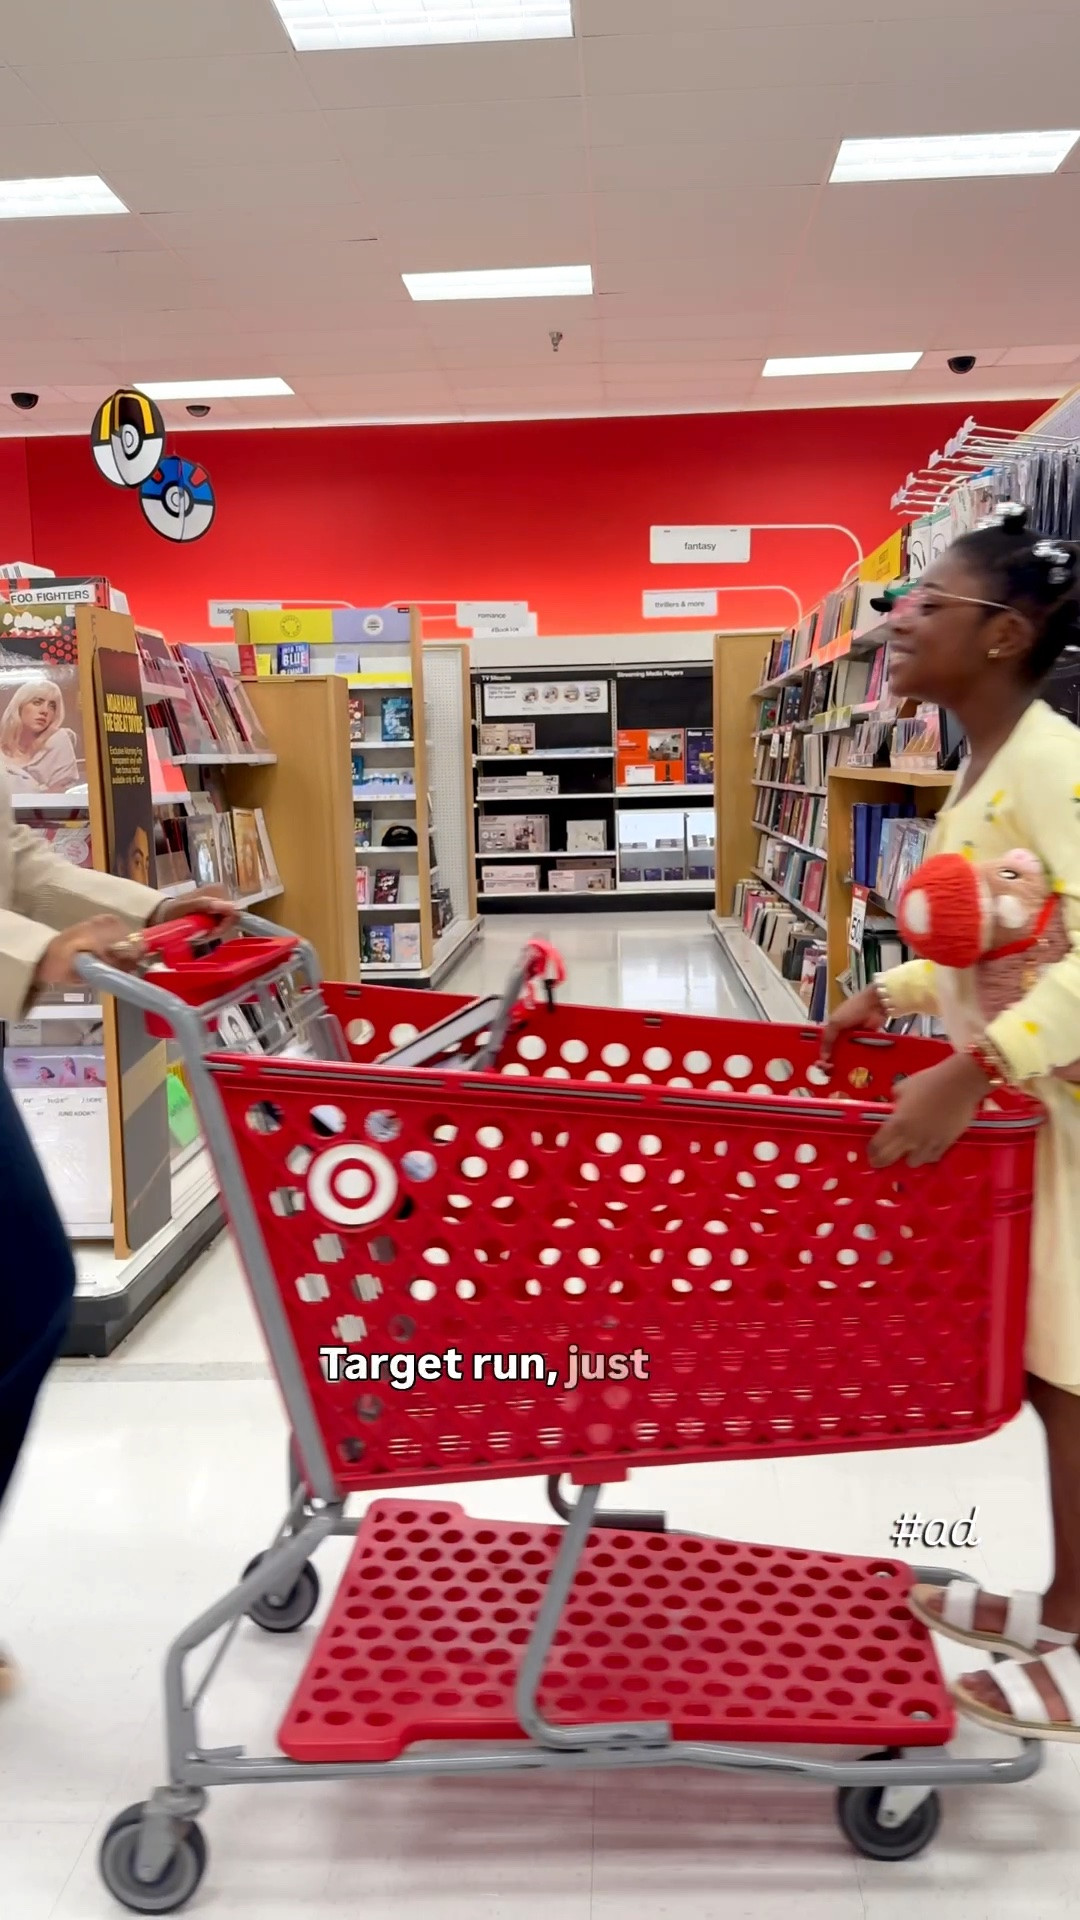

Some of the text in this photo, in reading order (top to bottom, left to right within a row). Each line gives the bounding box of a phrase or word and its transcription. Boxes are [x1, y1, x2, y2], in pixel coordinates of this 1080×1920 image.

[684, 542, 717, 551] fantasy
[10, 590, 90, 604] FOO FIGHTERS
[283, 652, 308, 667] BLUE
[103, 713, 114, 732] THE
[113, 714, 129, 733] GREAT
